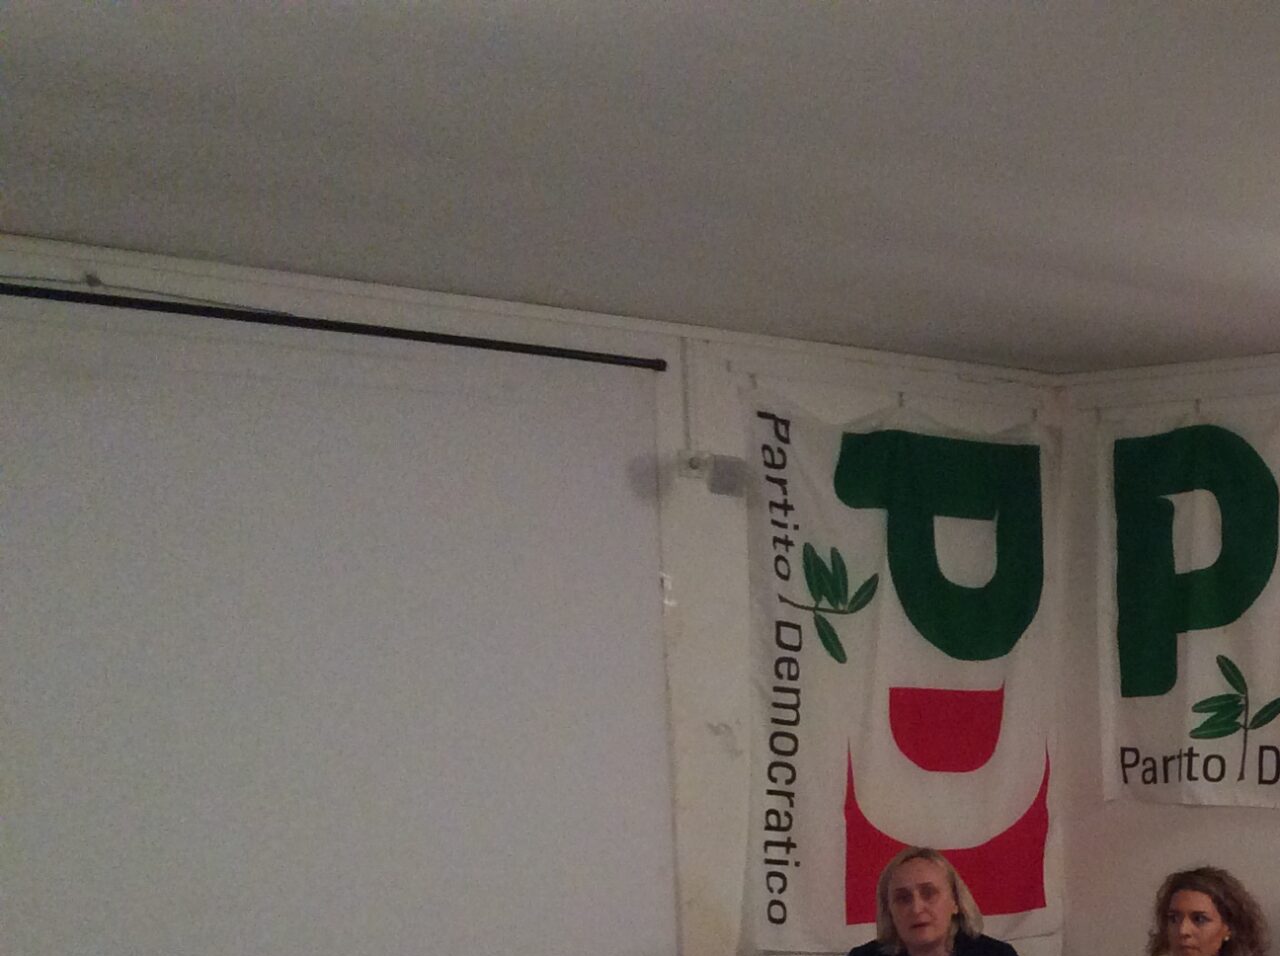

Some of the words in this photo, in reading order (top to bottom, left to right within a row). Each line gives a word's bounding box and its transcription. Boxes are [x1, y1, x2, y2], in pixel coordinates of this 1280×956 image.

[757, 410, 800, 582] Partito
[763, 620, 803, 925] Democratico
[1120, 746, 1226, 785] Partto
